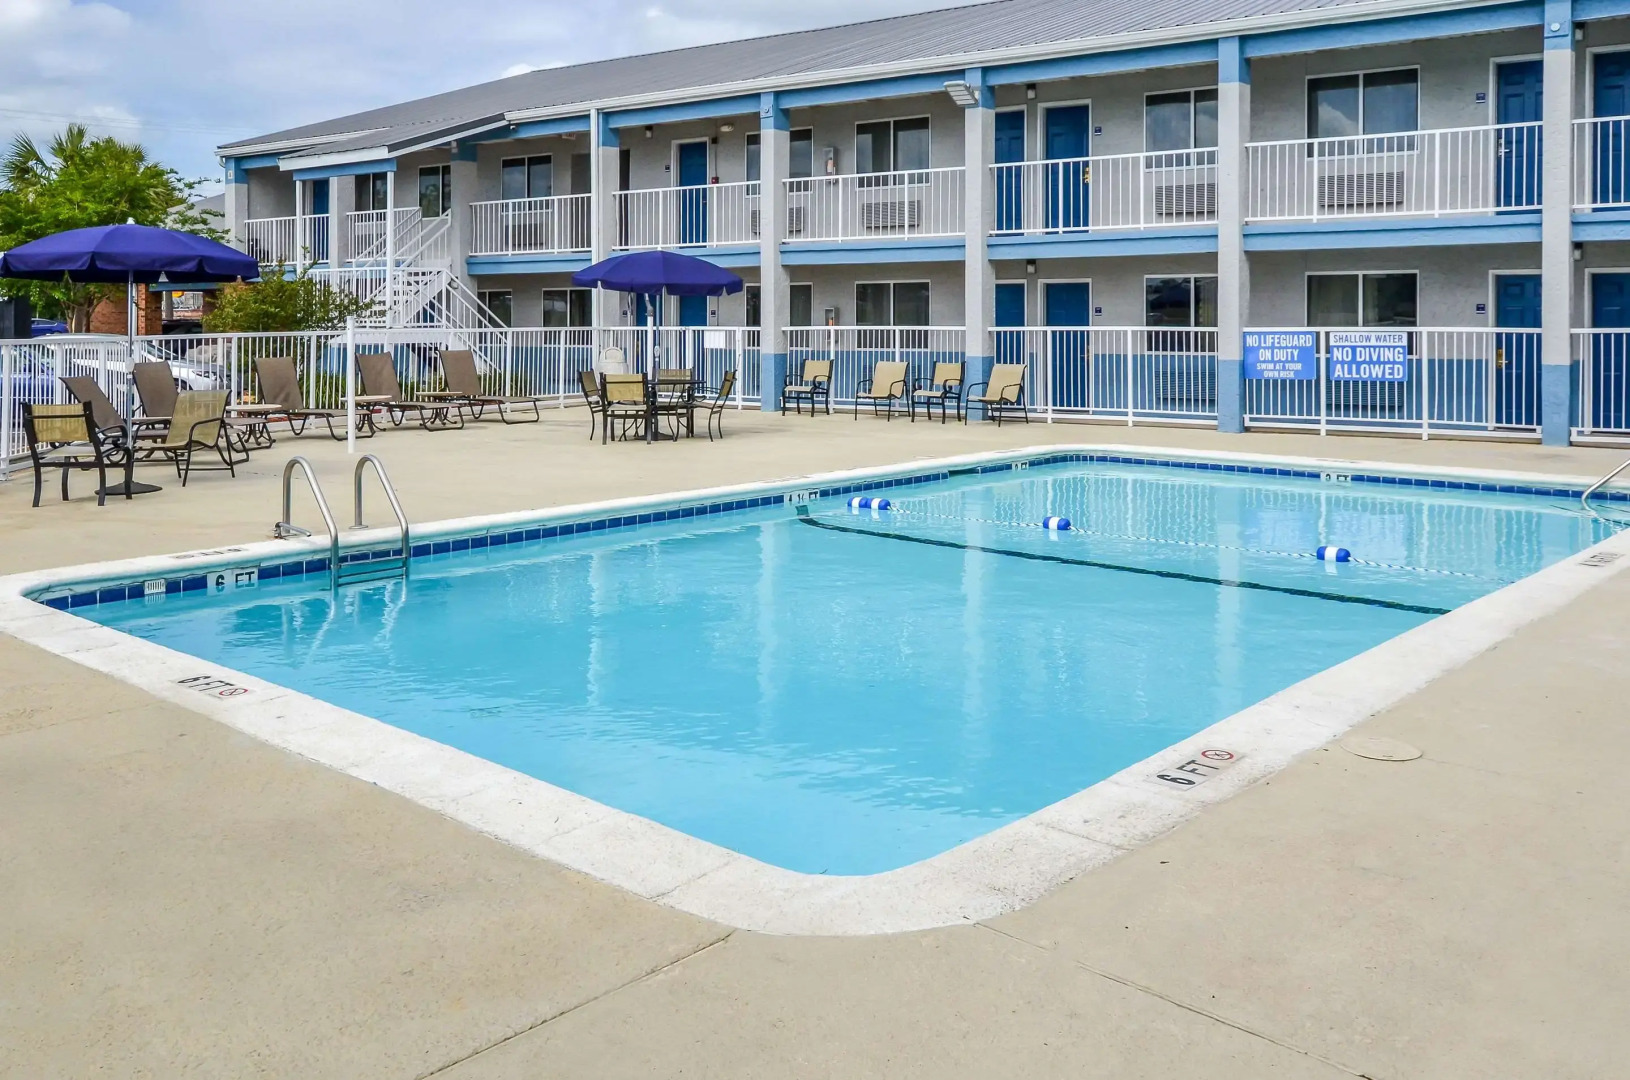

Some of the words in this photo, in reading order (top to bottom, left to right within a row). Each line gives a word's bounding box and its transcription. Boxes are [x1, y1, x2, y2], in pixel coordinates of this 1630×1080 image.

[1246, 334, 1259, 347] NO
[1261, 334, 1313, 347] LIFEGUARD
[1333, 334, 1372, 343] SHALLOW
[1374, 334, 1403, 343] WATER
[1259, 349, 1273, 361] ON
[1274, 349, 1299, 361] DUTY
[1333, 347, 1352, 362] NO
[1356, 347, 1404, 362] DIVING
[1264, 370, 1278, 378] OWN
[1279, 370, 1295, 378] RISK
[1334, 364, 1403, 378] ALLOWED
[177, 675, 212, 684] 6
[188, 680, 235, 692] FT
[1175, 759, 1220, 777] FT
[1156, 774, 1196, 786] 6
